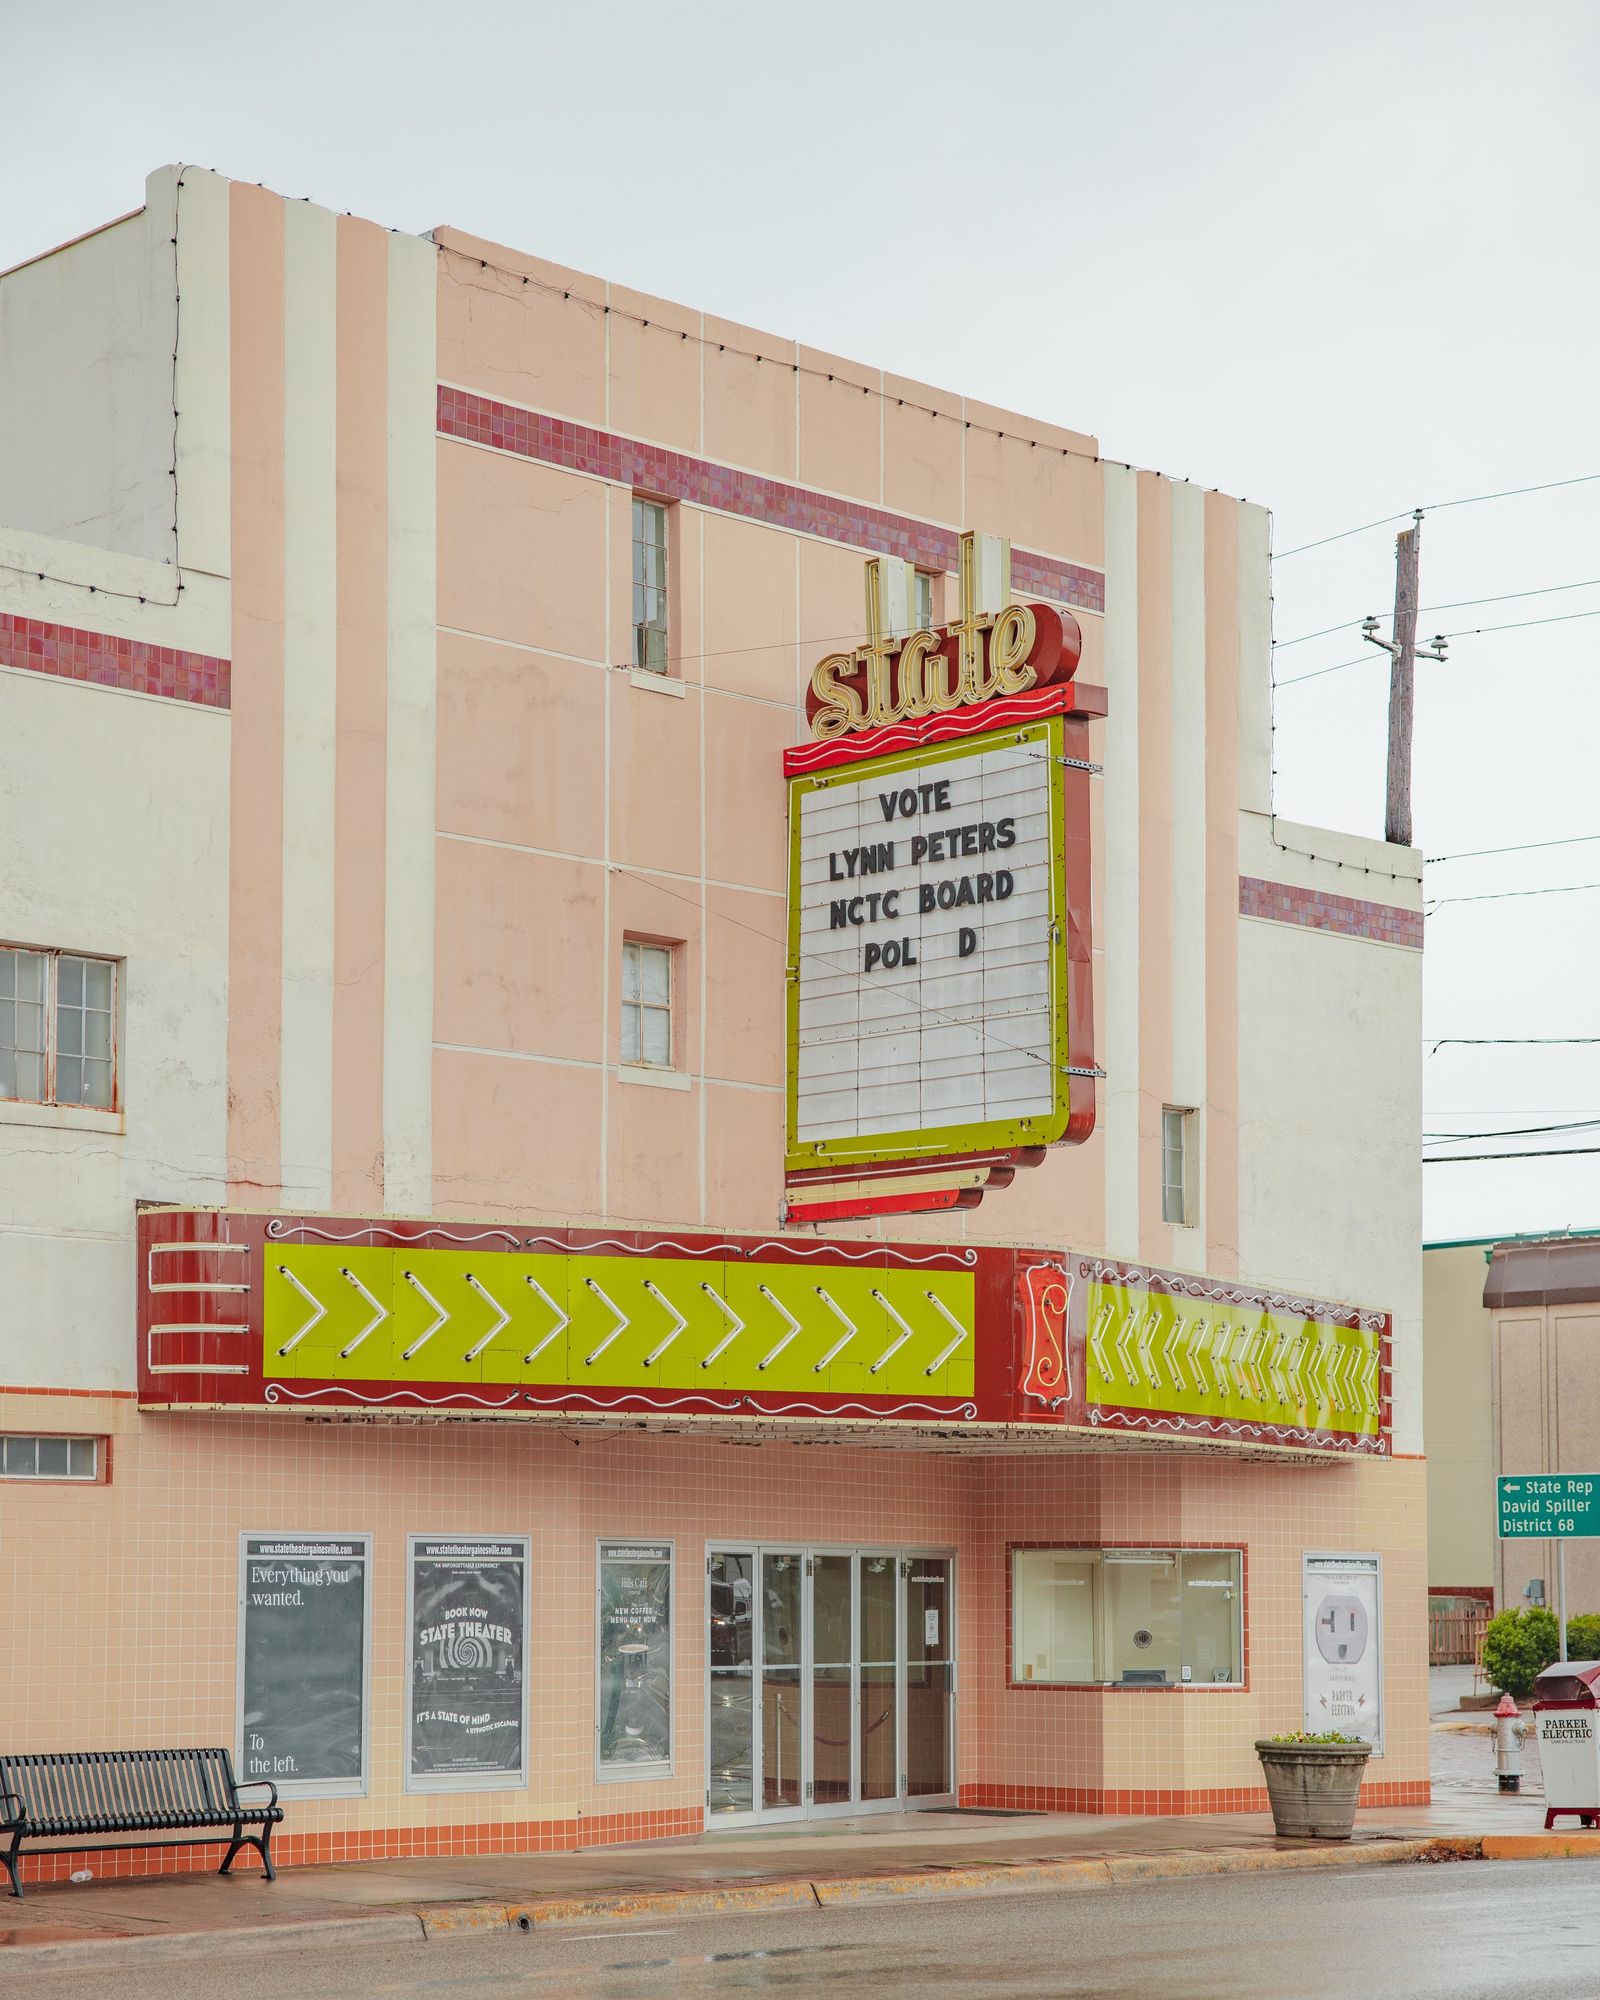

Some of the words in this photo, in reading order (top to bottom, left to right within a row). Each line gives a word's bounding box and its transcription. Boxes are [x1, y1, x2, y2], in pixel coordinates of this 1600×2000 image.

[879, 780, 951, 822] VOTE
[829, 841, 894, 881] LYNN
[912, 818, 1016, 865] PETERS
[830, 889, 899, 929] NCTC
[919, 870, 1014, 914] BOARD
[865, 937, 916, 972] POL
[959, 927, 976, 957] D
[1526, 1481, 1561, 1494] State
[1567, 1480, 1593, 1496] Rep
[1502, 1499, 1540, 1513] David
[1546, 1499, 1591, 1515] Spiller
[1503, 1518, 1552, 1532] District
[1558, 1519, 1574, 1532] 68
[260, 1544, 353, 1556] www.statetheatergainesville.com
[426, 1545, 513, 1556] www.statetheatergainesville.com
[252, 1566, 323, 1586] Everything
[326, 1569, 349, 1586] you
[252, 1590, 304, 1606] wanted.
[445, 1607, 468, 1620] BOOK
[469, 1607, 488, 1619] NOW
[420, 1622, 455, 1645] STATE
[458, 1622, 513, 1645] THEATER
[1331, 1690, 1353, 1701] PARKER
[416, 1711, 429, 1723] IT'S
[431, 1711, 436, 1720] A
[437, 1711, 458, 1723] STATE
[459, 1715, 470, 1725] OF
[472, 1713, 491, 1725] MIND
[1331, 1705, 1355, 1716] ELECTRIC
[470, 1724, 493, 1734] HYPNOTIC
[494, 1720, 519, 1728] ESCAPADE
[1545, 1719, 1588, 1729] PARKER
[249, 1733, 264, 1750] To
[1542, 1729, 1593, 1739] ELECTRIC
[250, 1757, 270, 1773] the
[274, 1755, 299, 1772] left.
